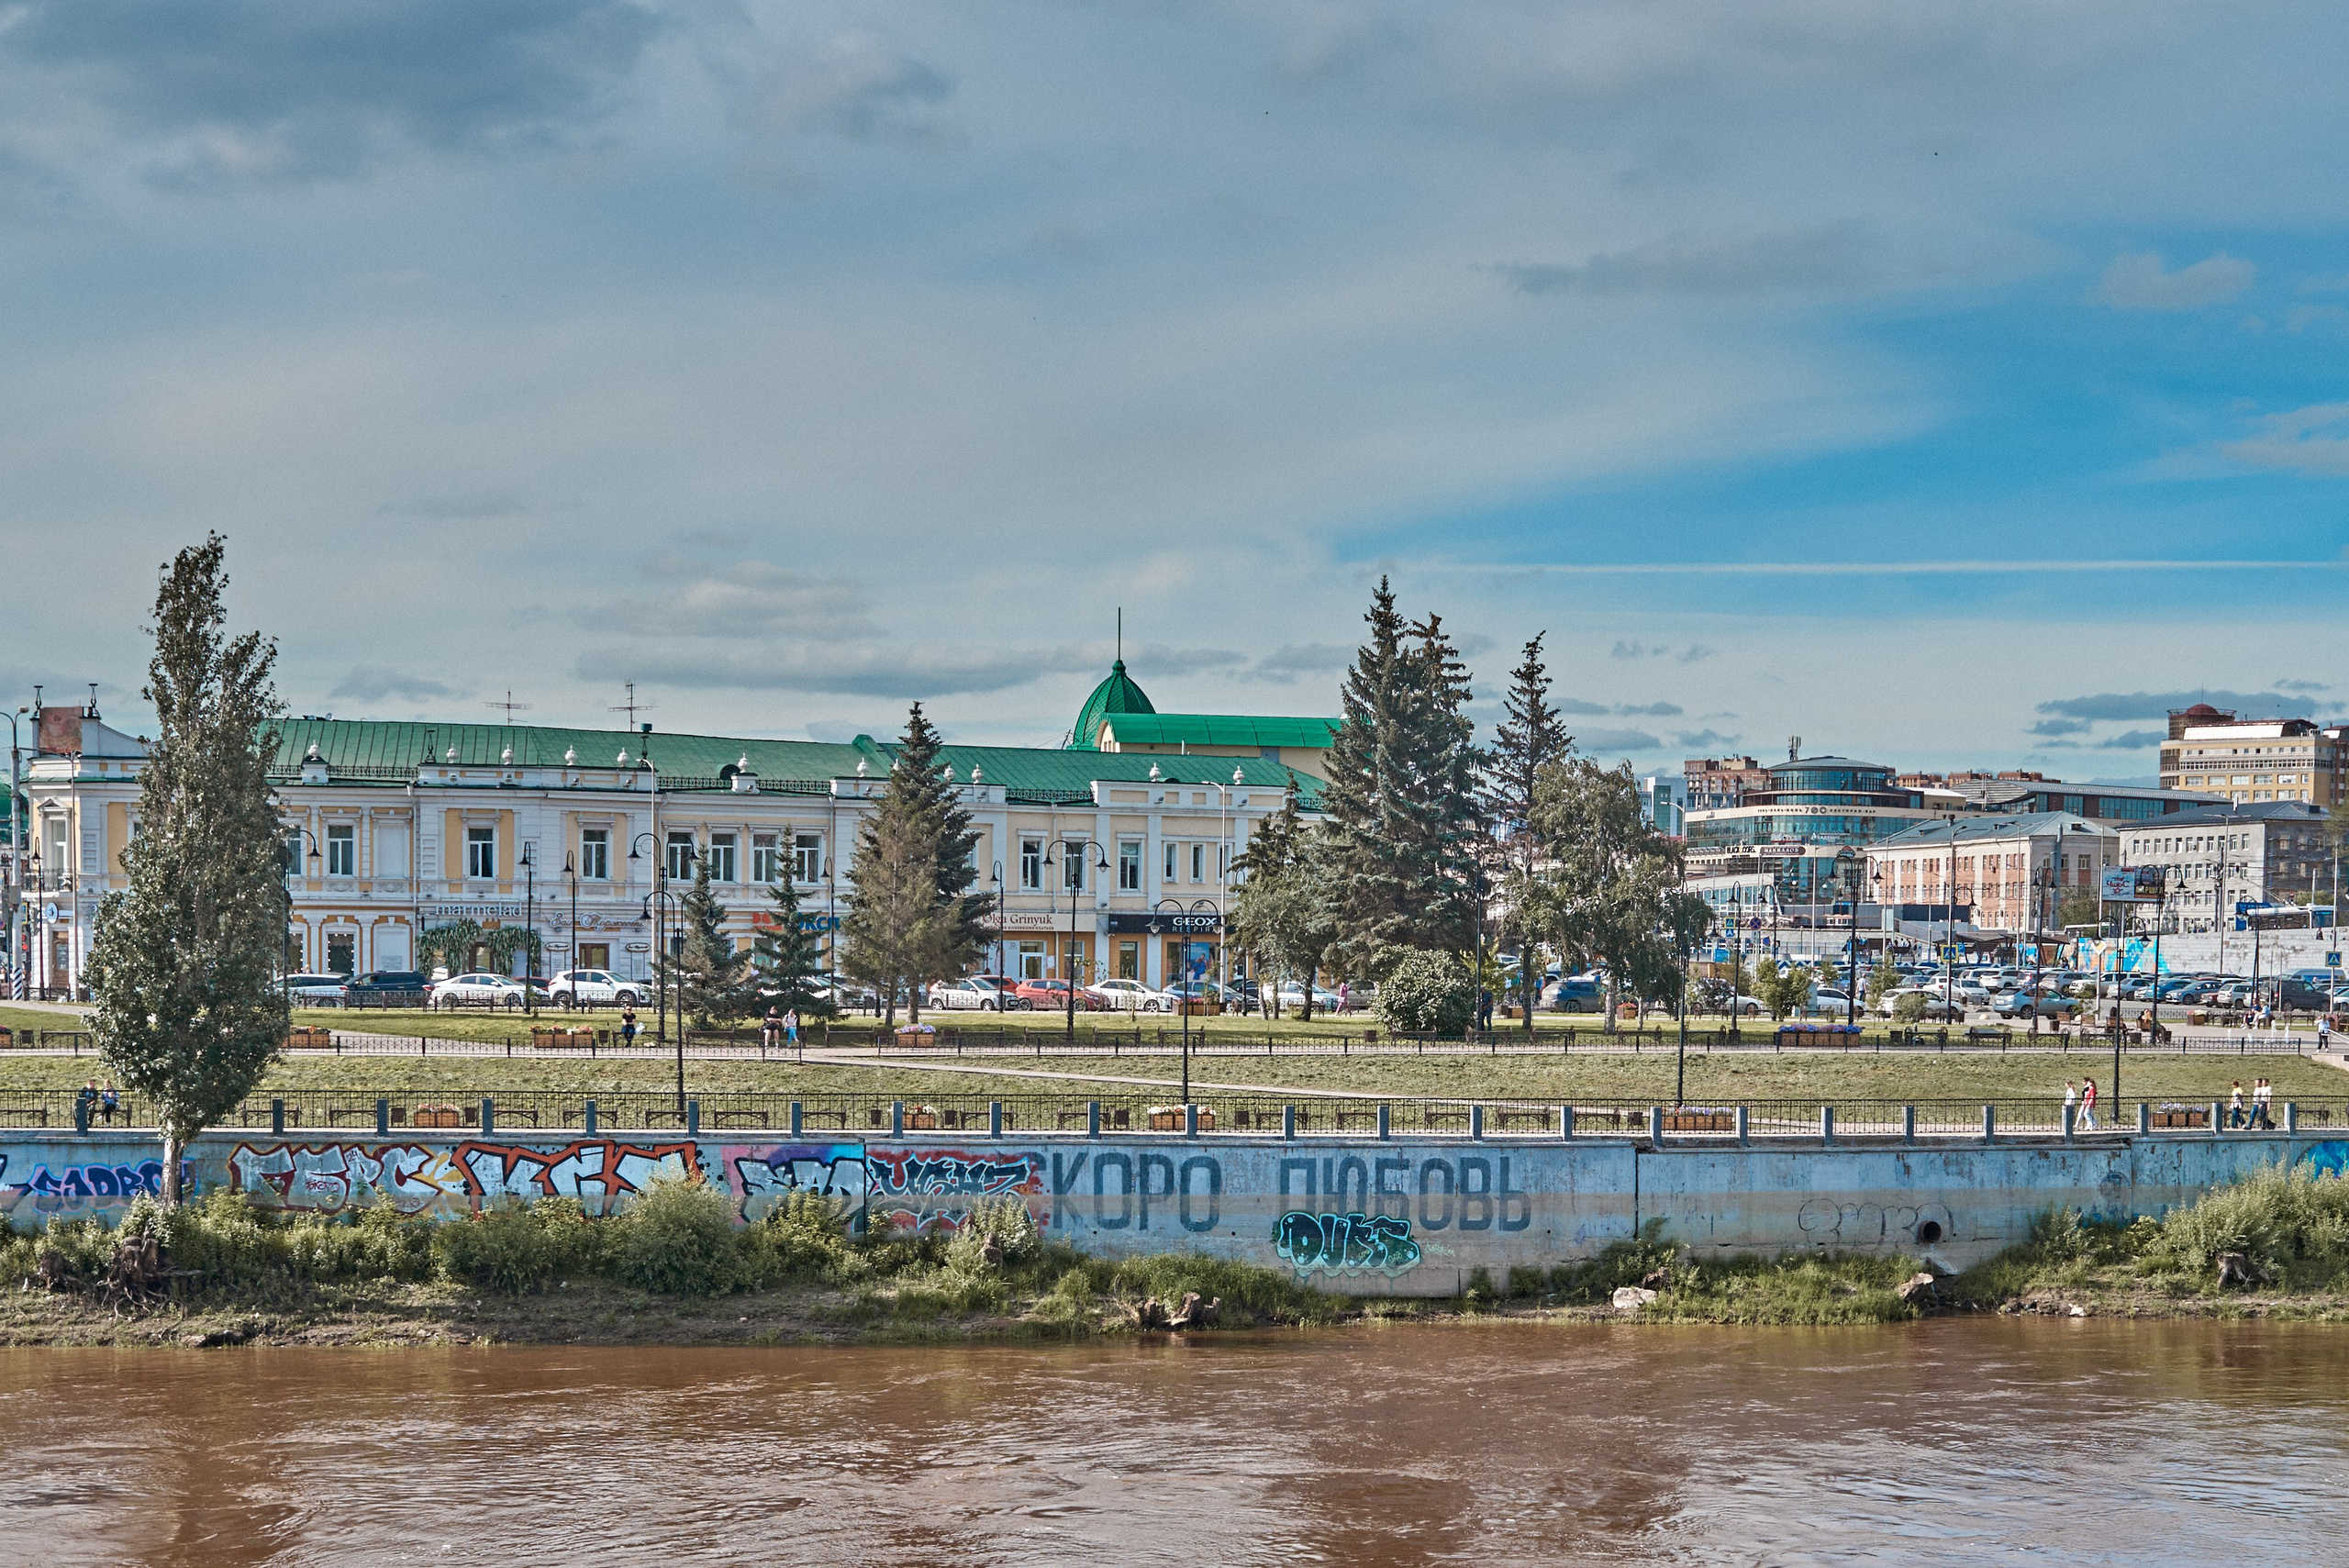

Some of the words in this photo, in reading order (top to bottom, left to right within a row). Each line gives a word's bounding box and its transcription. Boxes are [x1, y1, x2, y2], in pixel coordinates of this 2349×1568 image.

[1805, 806, 1827, 815] 700
[435, 902, 522, 917] marmelad
[1009, 913, 1052, 927] Grinyuk
[1173, 917, 1217, 927] GEOX
